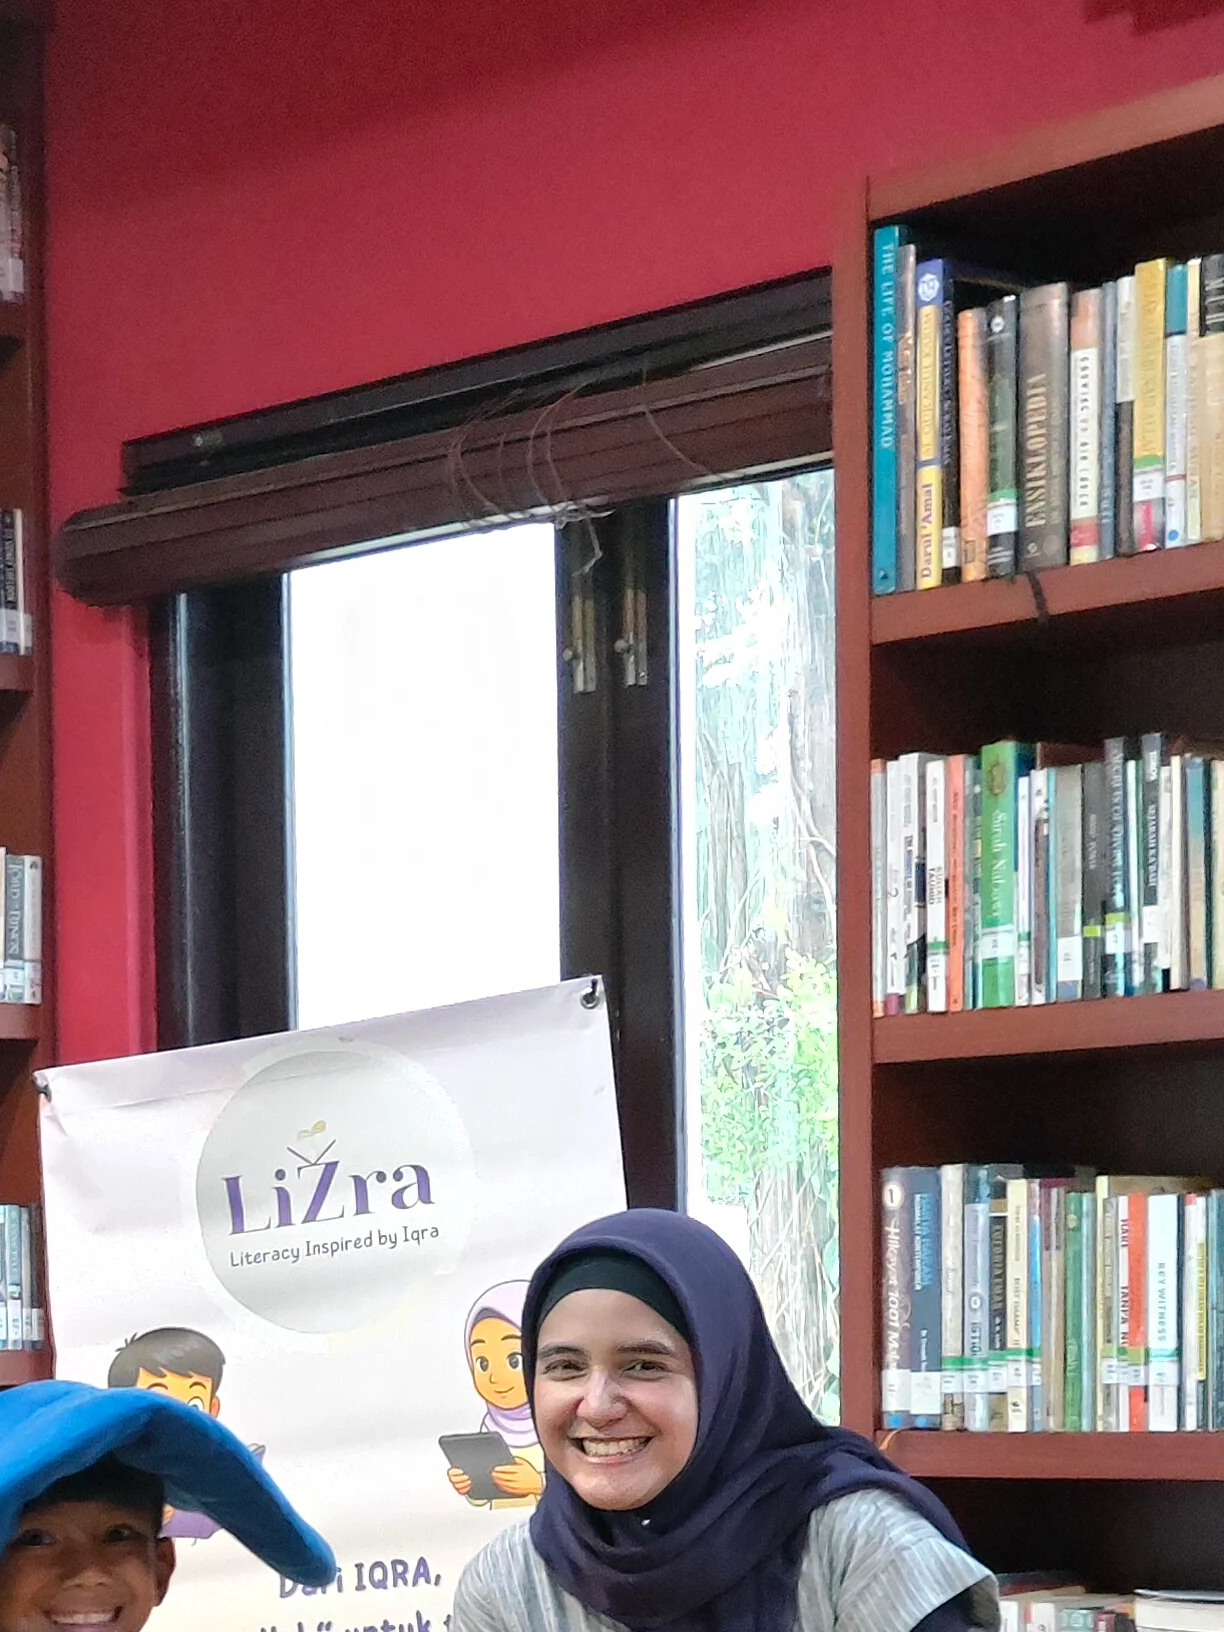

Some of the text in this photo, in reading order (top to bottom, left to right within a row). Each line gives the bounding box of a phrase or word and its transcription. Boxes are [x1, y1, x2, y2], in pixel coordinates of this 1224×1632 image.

[881, 243, 894, 266] THE
[881, 278, 894, 316] LIFE
[881, 322, 894, 343] OF
[990, 811, 1008, 853] Sirah
[8, 865, 24, 900] LORD
[229, 1223, 440, 1268] Literacy Inspired by Iqra
[888, 1290, 901, 1327] 1001
[354, 1556, 442, 1592] IQRA,
